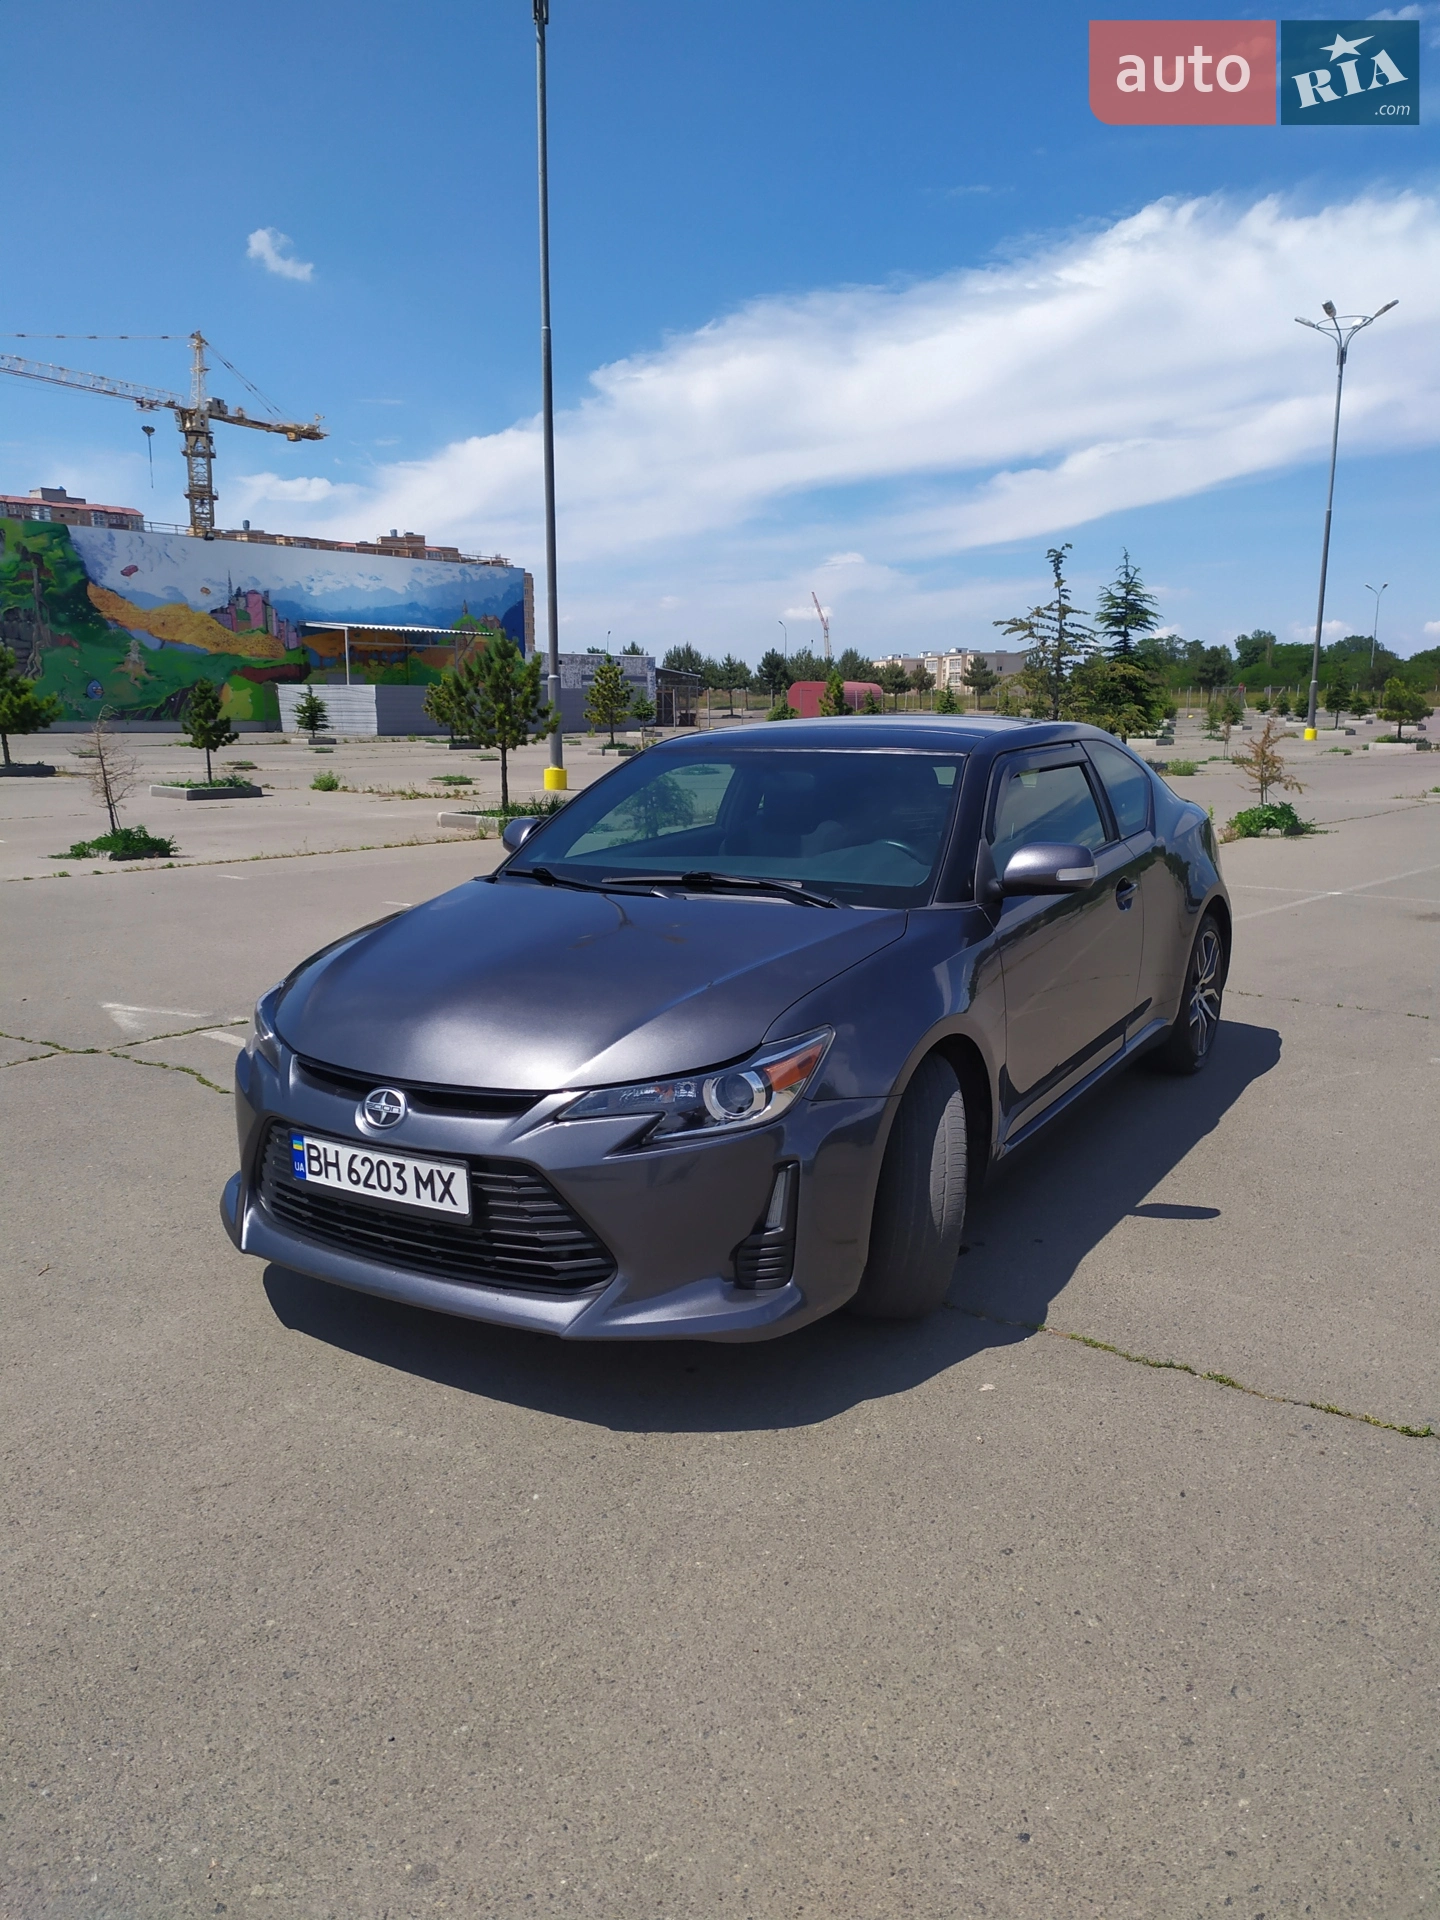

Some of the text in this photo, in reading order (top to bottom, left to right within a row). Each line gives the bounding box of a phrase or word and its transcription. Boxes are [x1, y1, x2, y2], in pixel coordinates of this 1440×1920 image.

[294, 1162, 305, 1173] UA
[307, 1144, 458, 1205] BH 6203 MX
